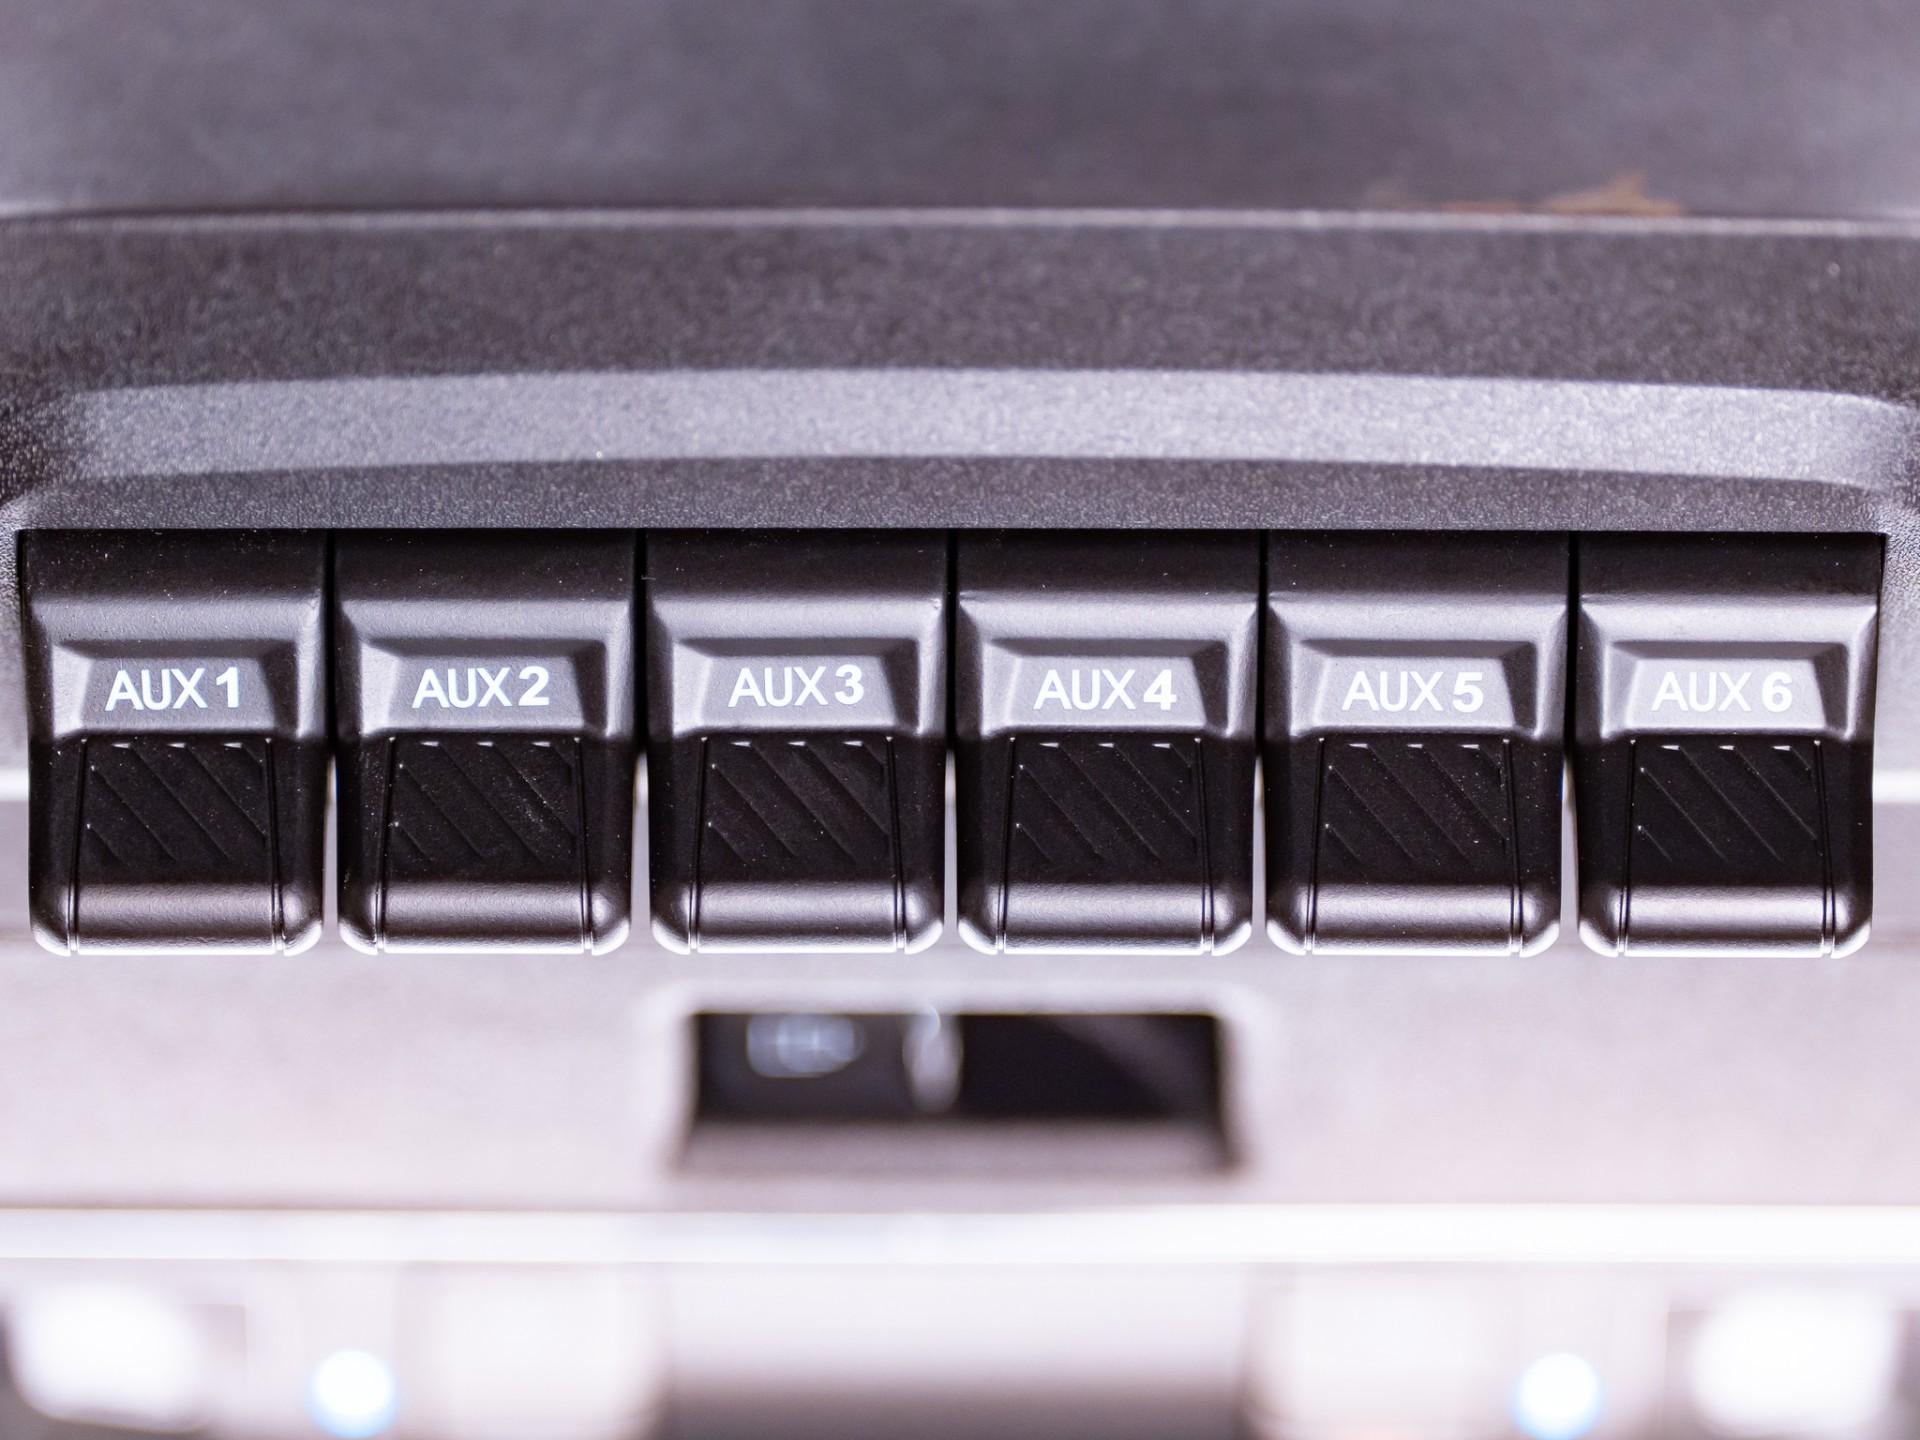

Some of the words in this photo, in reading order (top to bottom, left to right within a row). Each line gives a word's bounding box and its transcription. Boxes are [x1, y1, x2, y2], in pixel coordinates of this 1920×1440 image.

[105, 667, 208, 711] AUX
[214, 665, 240, 709] 1
[411, 667, 513, 709] AUX
[518, 664, 550, 707] 2
[727, 665, 829, 708] AUX
[834, 663, 866, 706] 3
[1033, 668, 1136, 711] AUX
[1142, 668, 1177, 711] 4
[1342, 670, 1444, 712] AUX
[1451, 671, 1485, 713] 5
[1651, 671, 1752, 712] AUX
[1761, 671, 1793, 713] 6
